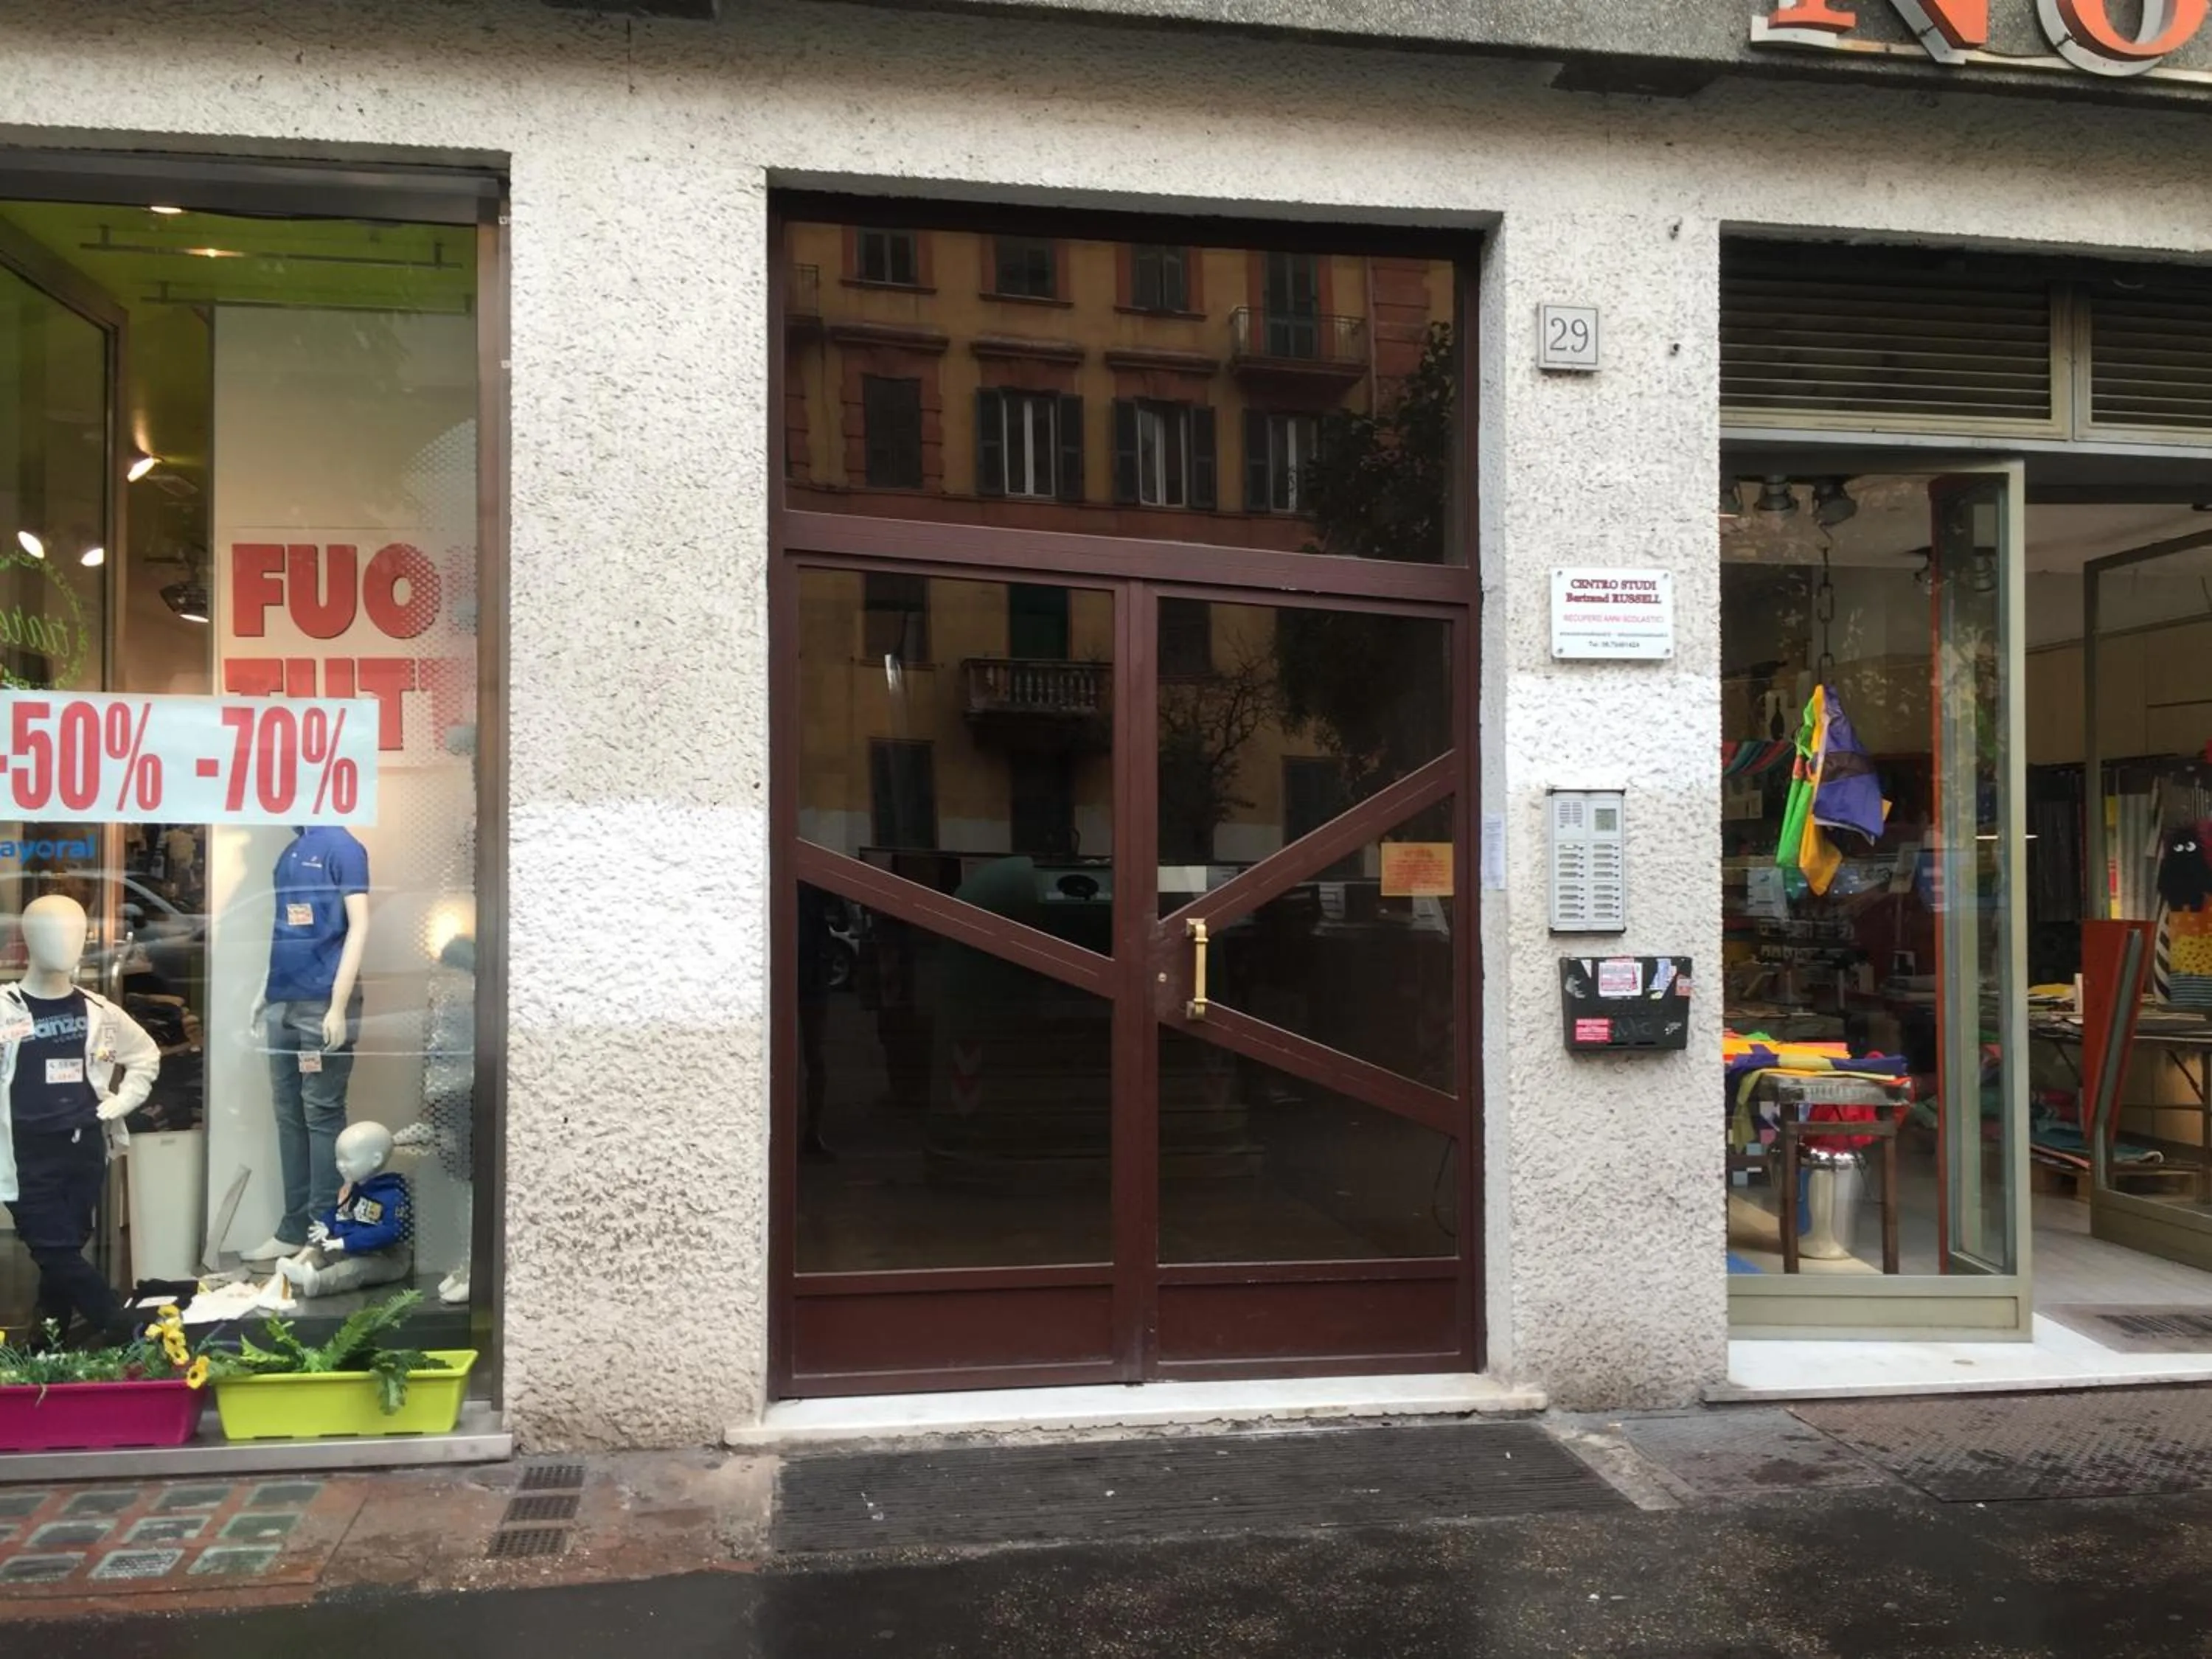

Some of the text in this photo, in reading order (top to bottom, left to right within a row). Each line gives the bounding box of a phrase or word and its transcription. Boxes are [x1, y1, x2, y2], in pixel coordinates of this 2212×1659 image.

[1550, 316, 1589, 353] 29
[1571, 579, 1657, 591] CENTRO STUDI
[0, 701, 358, 815] -50% -70%
